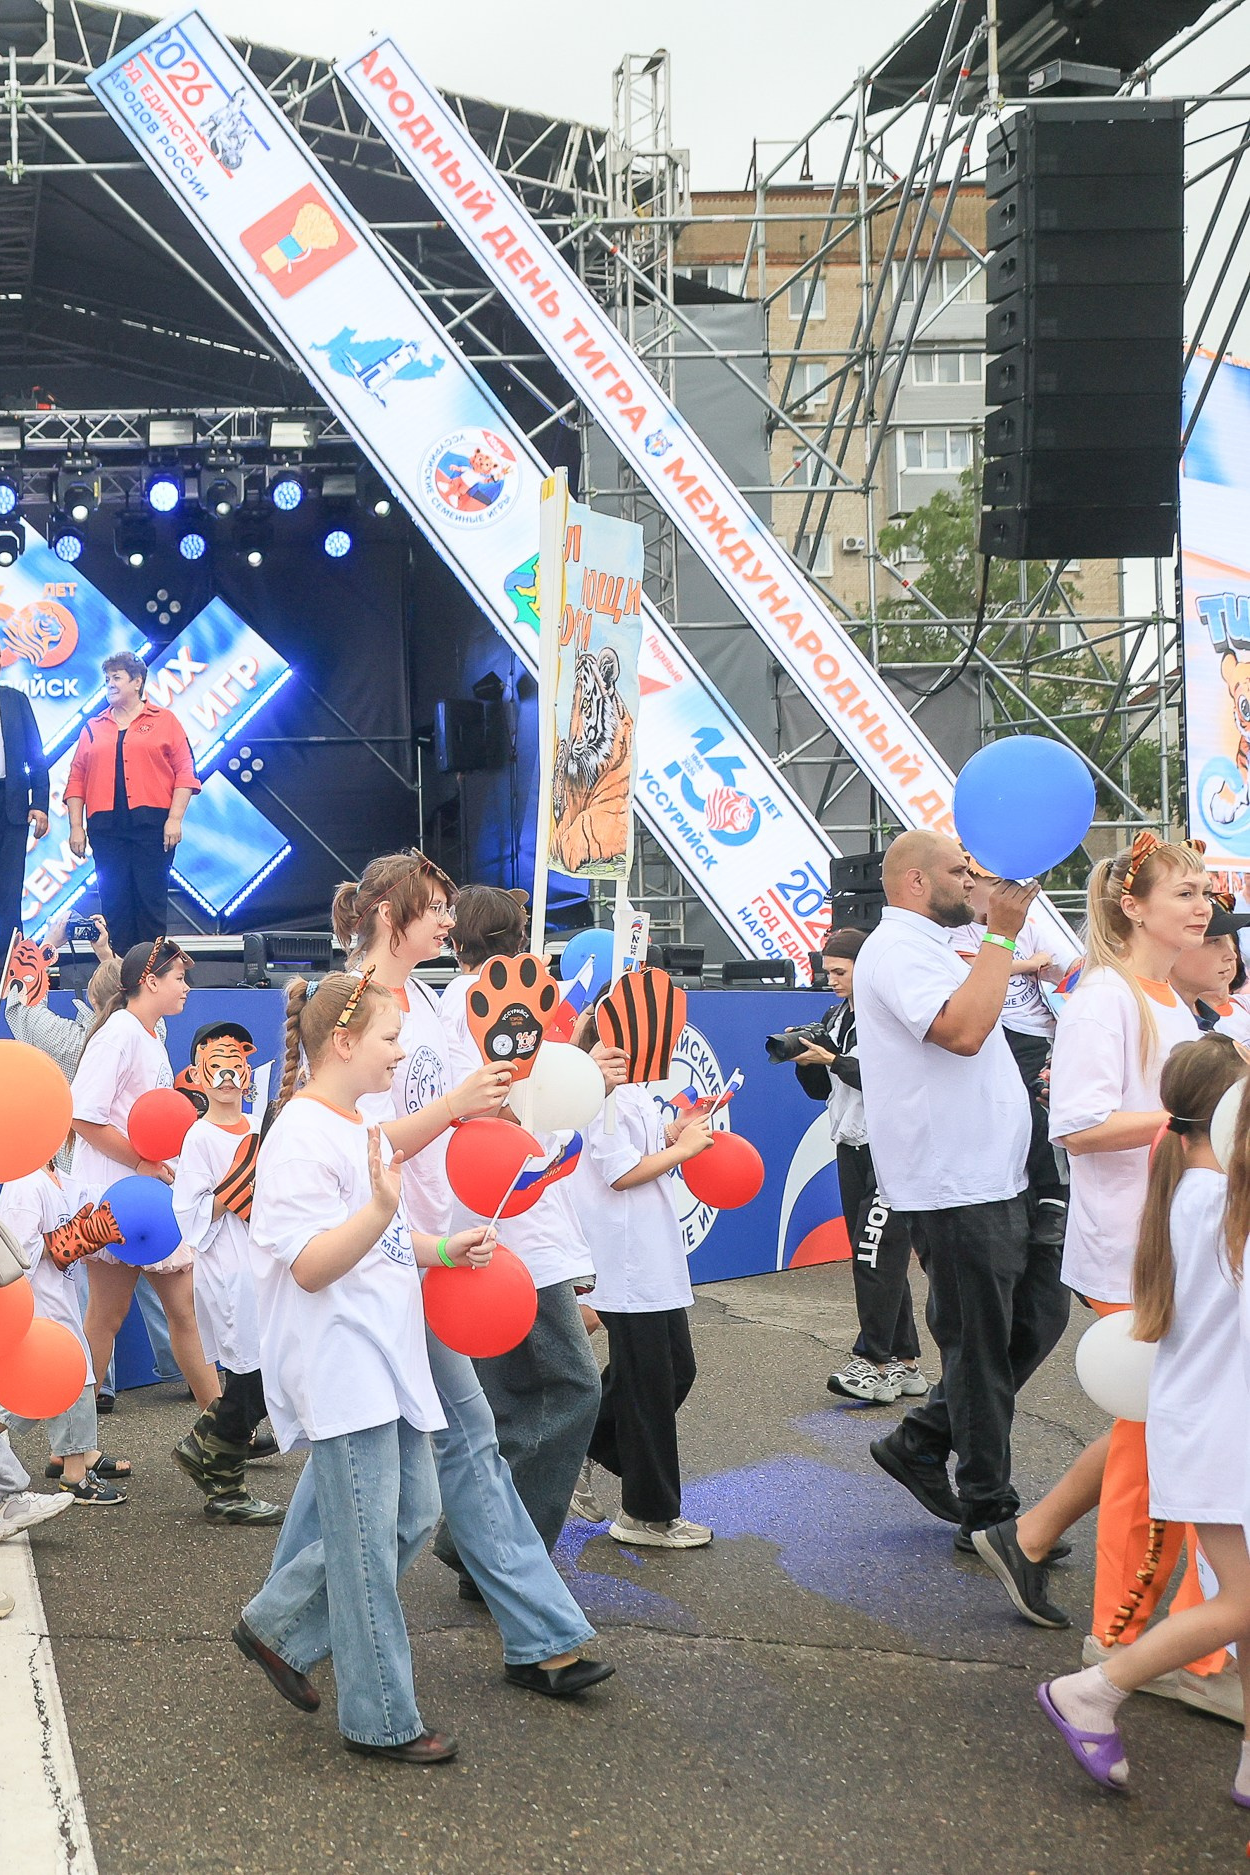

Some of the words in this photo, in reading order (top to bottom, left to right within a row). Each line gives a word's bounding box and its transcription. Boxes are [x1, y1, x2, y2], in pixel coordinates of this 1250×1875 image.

[140, 84, 204, 167] ЕДИНСТВА
[157, 135, 209, 200] РОССИИ
[481, 224, 561, 319] ДЕНЬ
[562, 317, 648, 433] ТИГРА
[42, 582, 77, 597] ЛЕТ
[645, 634, 683, 683] Первые
[663, 457, 924, 787] МЕЖДУНАРОДНЫЙ
[908, 789, 960, 842] ДЕ
[189, 655, 259, 731] ИГР
[639, 769, 718, 871] УССУРИЙСК
[758, 795, 783, 820] ЛЕТ
[751, 896, 780, 932] ГОД
[775, 869, 834, 948] 202
[676, 1028, 722, 1096] ЙСКИЕ
